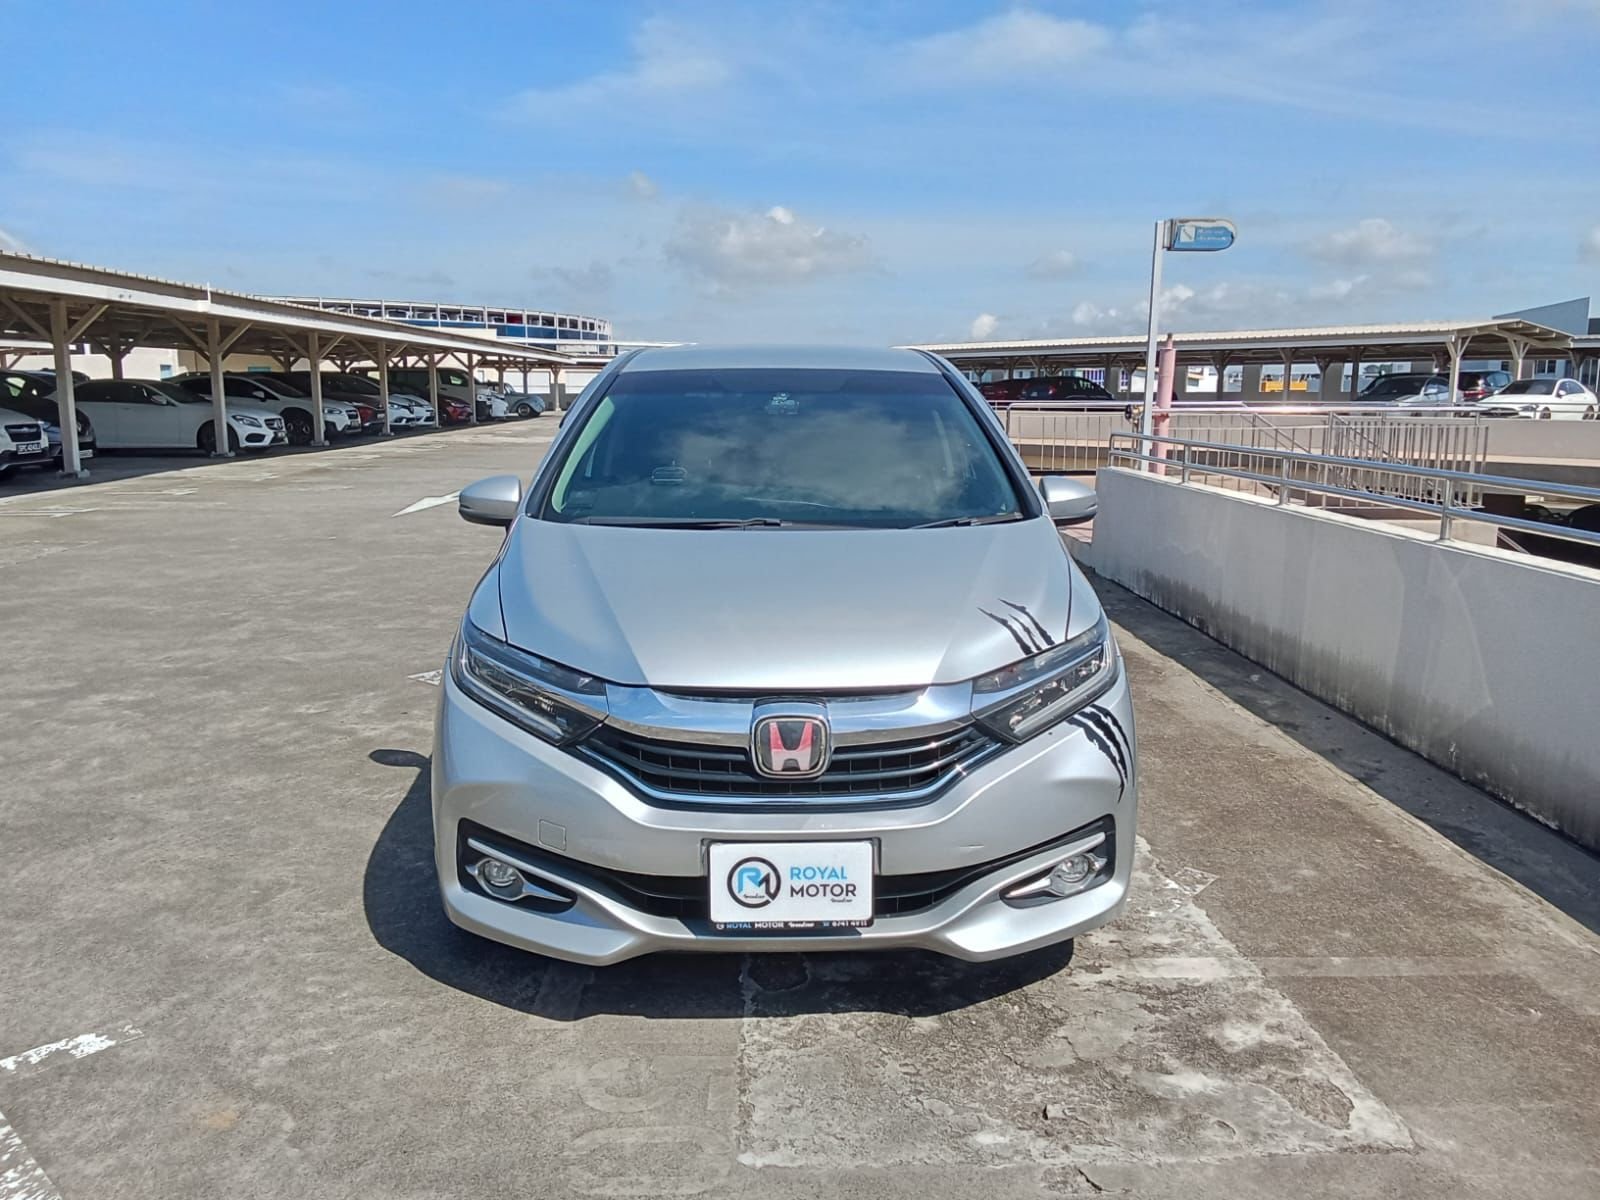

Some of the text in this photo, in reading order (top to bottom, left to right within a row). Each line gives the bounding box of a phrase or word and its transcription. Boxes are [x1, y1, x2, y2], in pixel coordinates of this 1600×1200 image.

[790, 866, 848, 880] ROYAL
[790, 883, 857, 898] MOTOR
[754, 921, 784, 929] MOTOR
